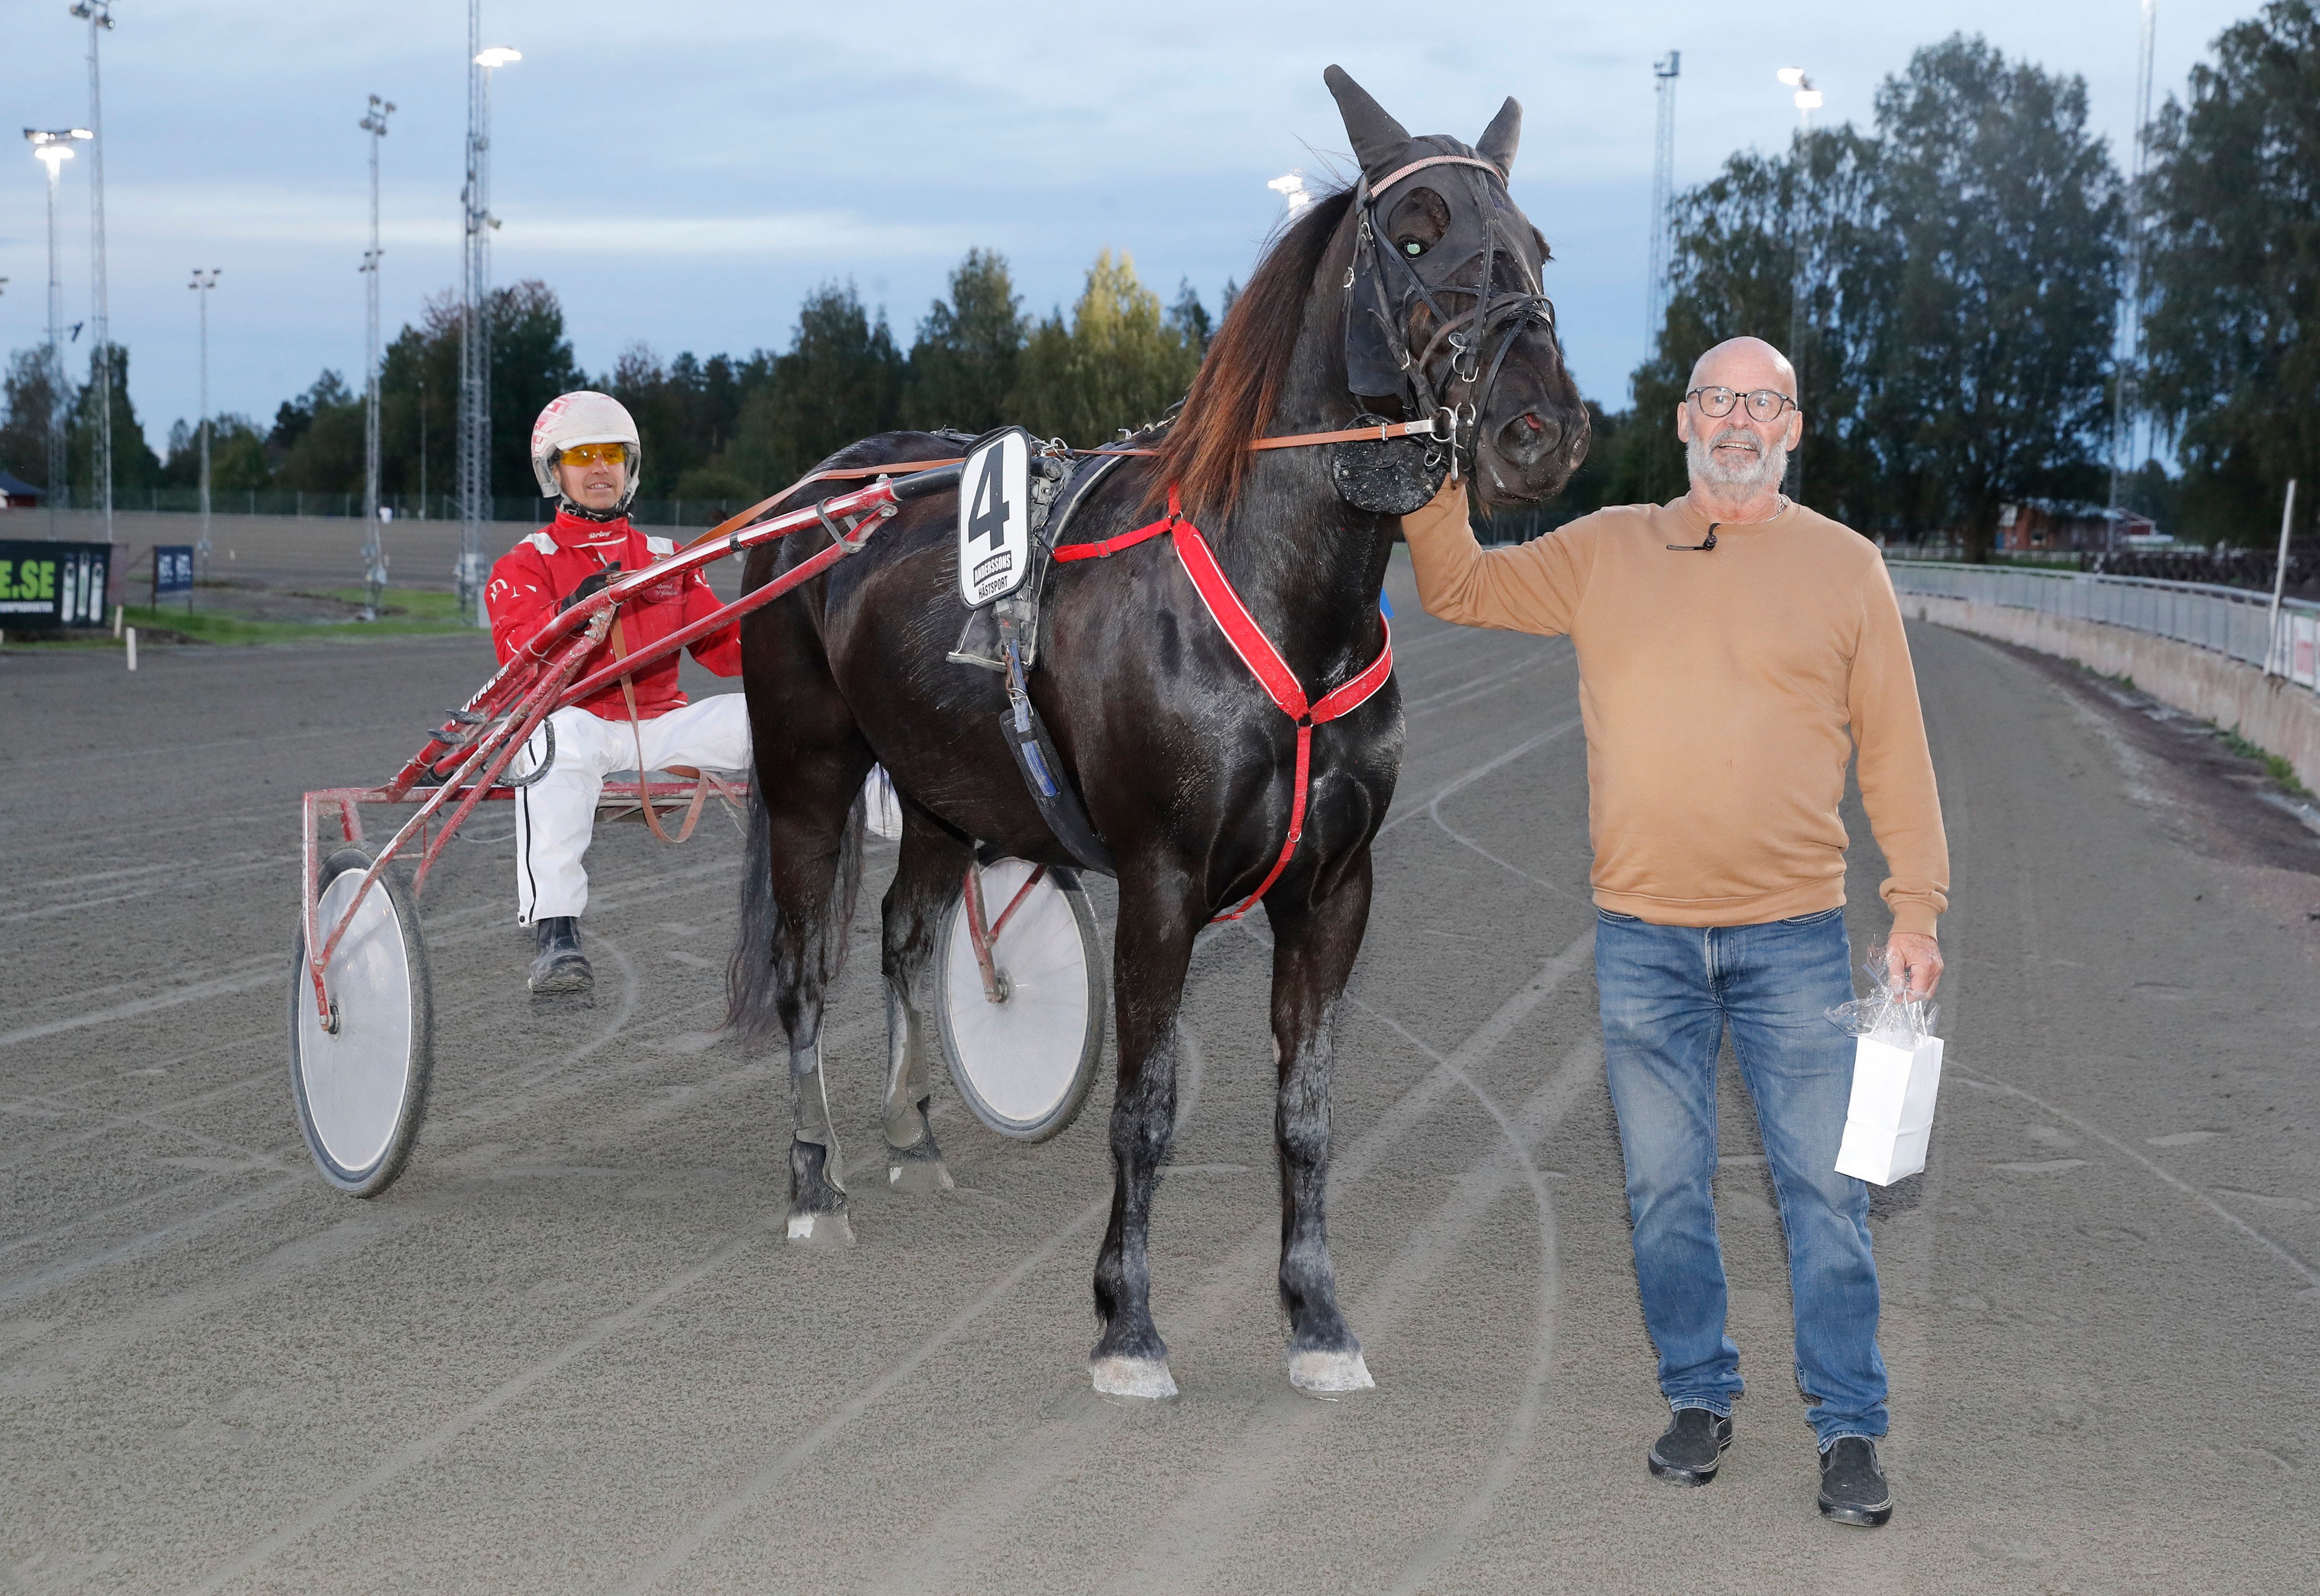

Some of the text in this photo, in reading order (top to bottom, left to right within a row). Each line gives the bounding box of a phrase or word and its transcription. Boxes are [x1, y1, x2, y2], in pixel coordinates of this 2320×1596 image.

[968, 440, 1010, 551] 4
[975, 554, 1011, 584] ANDERSSONS
[978, 575, 1008, 599] HÄSTSPORT
